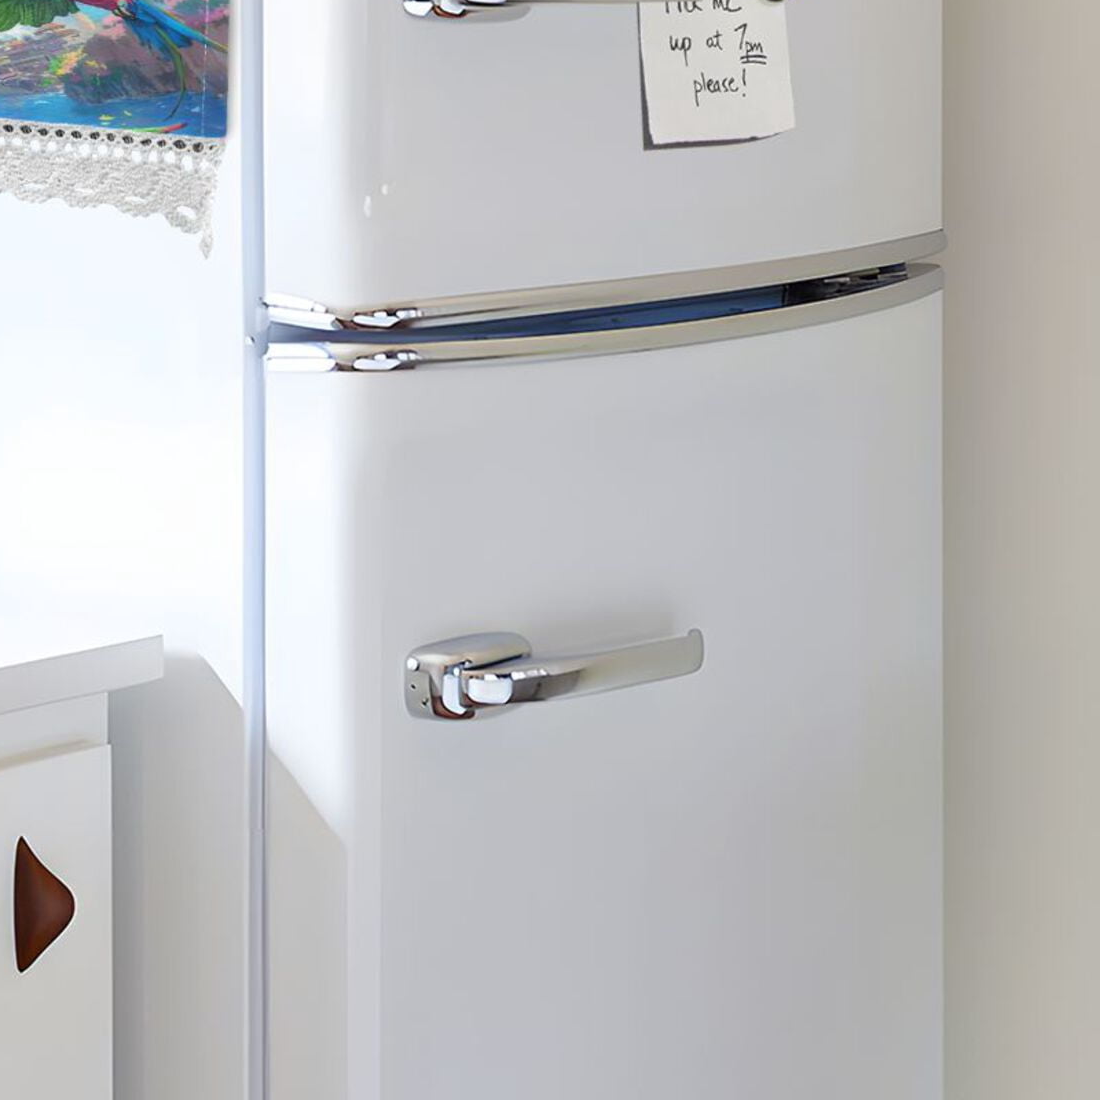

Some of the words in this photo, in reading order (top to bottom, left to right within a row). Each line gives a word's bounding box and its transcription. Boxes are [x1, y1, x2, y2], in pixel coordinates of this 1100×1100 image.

[669, 35, 692, 66] up
[706, 30, 723, 50] at
[734, 23, 765, 63] 7pm
[693, 68, 747, 107] please!
